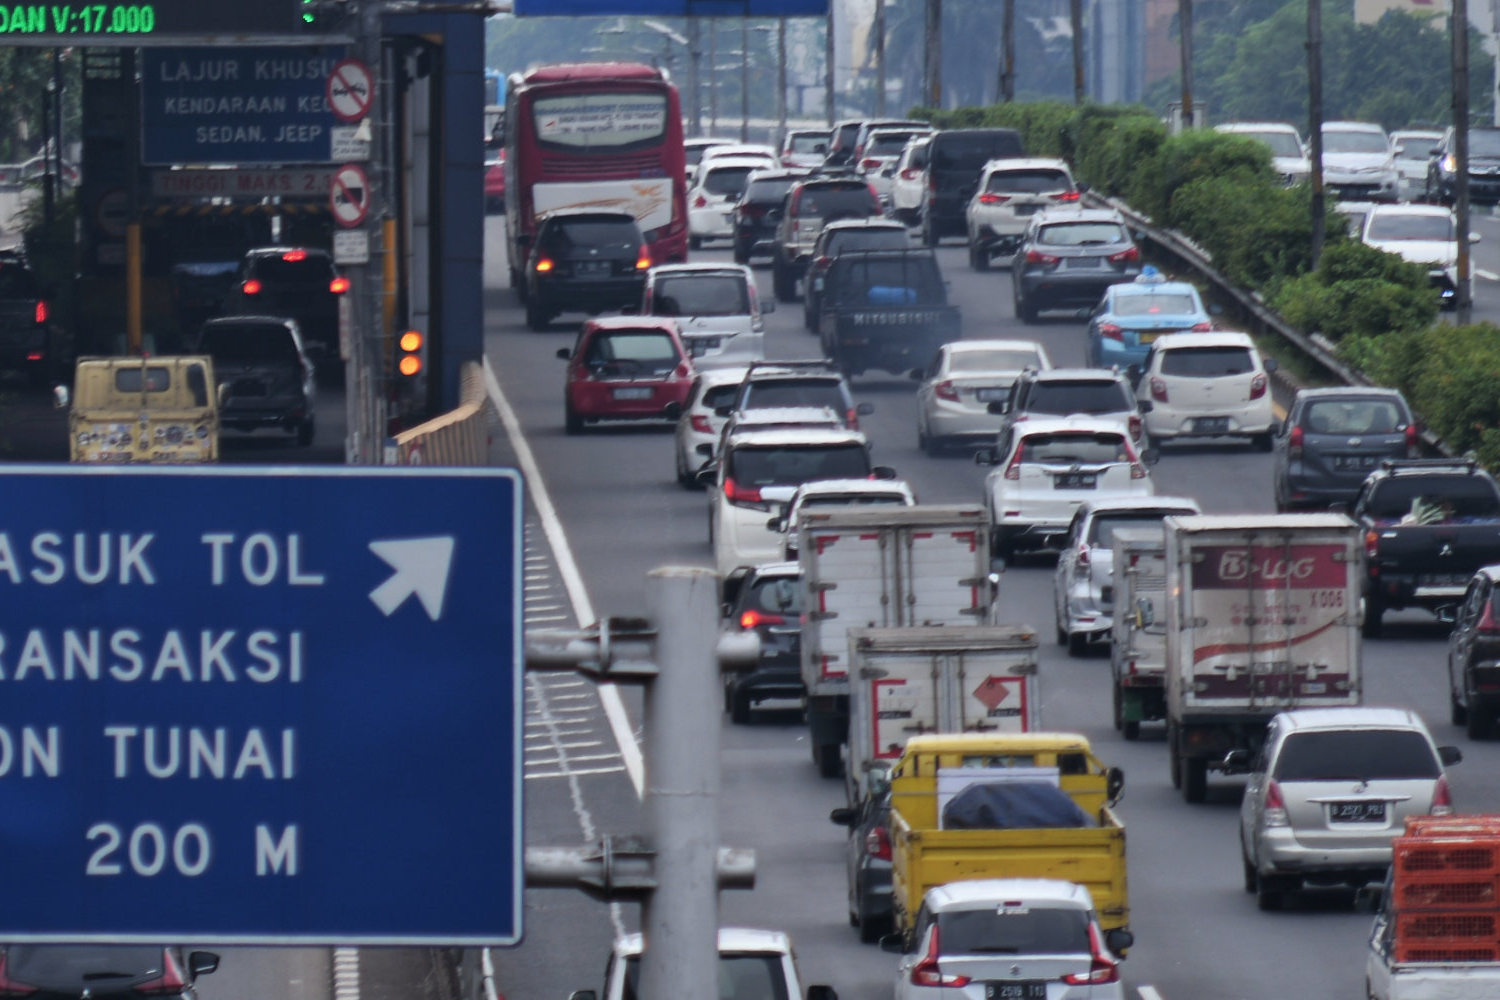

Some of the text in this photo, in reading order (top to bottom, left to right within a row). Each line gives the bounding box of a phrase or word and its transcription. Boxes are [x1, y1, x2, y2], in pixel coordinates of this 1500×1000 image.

[160, 60, 239, 82] LAJUR
[164, 97, 286, 114] KENDARAAN
[274, 126, 322, 142] JEEP
[162, 174, 225, 192] TINGGI
[854, 312, 940, 326] MITSUBISHI
[201, 533, 325, 586] TOL
[104, 726, 295, 779] TUNAI
[85, 824, 299, 877] 200 M
